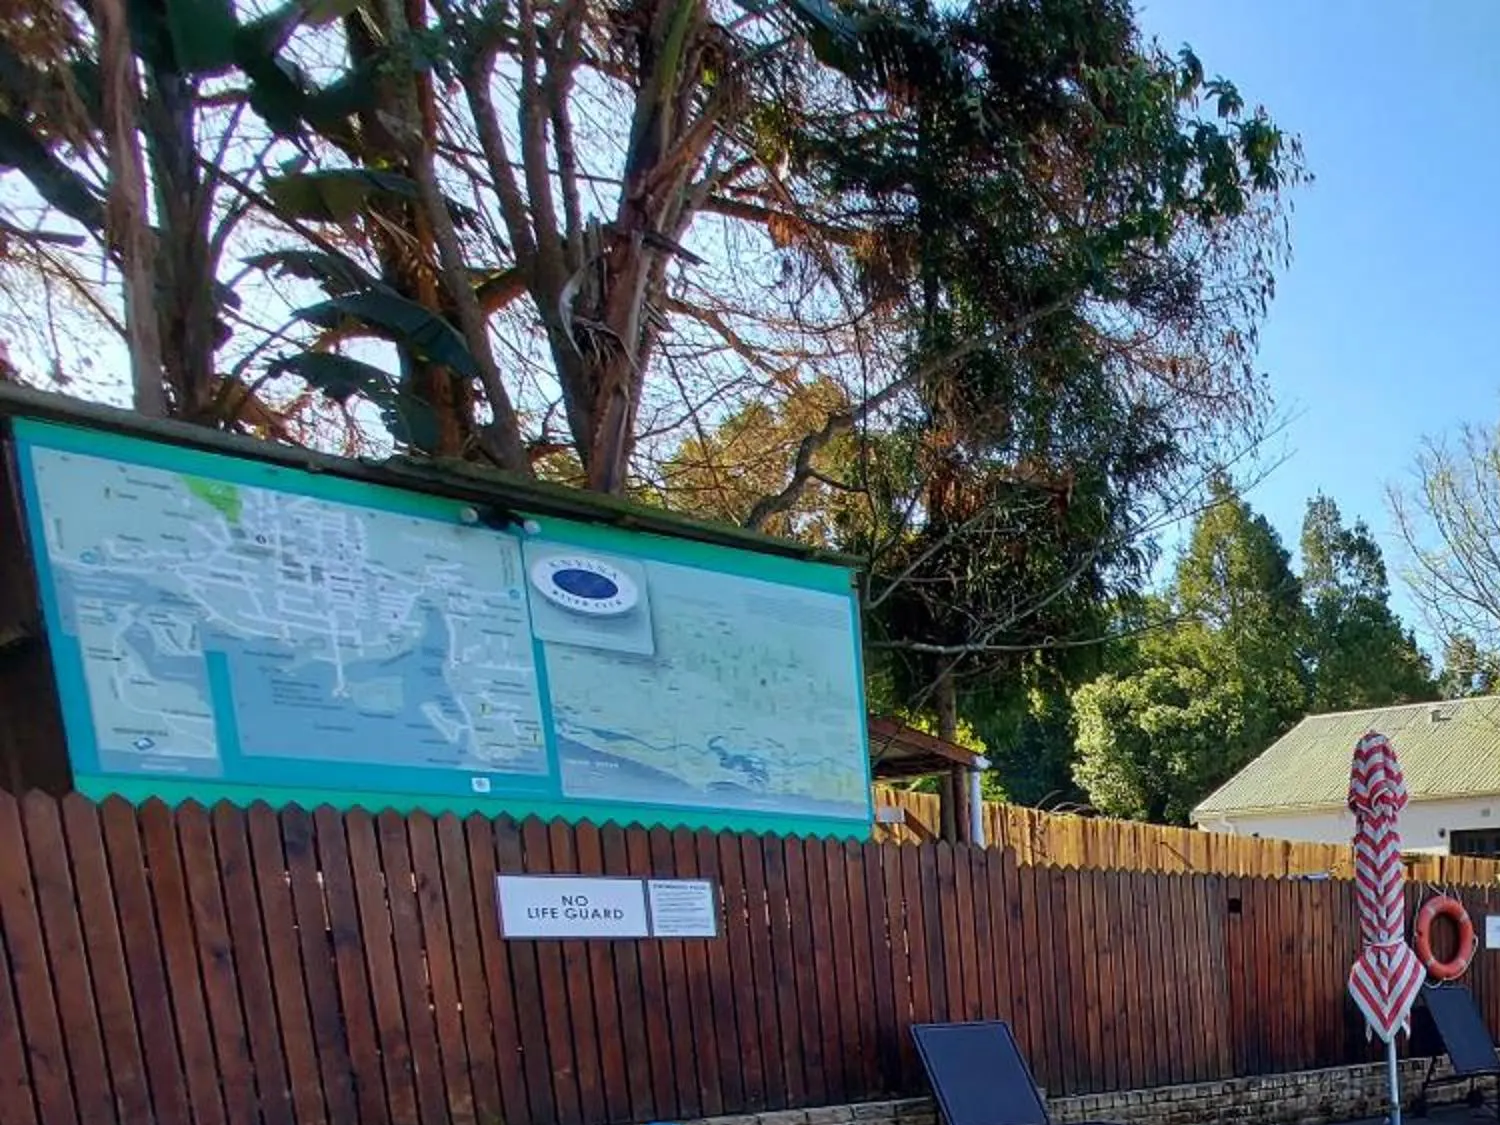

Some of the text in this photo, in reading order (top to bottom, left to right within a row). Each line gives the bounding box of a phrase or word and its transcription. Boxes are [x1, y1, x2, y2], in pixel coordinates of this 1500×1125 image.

[561, 895, 589, 907] NO
[527, 907, 625, 921] LIFE GUARD
